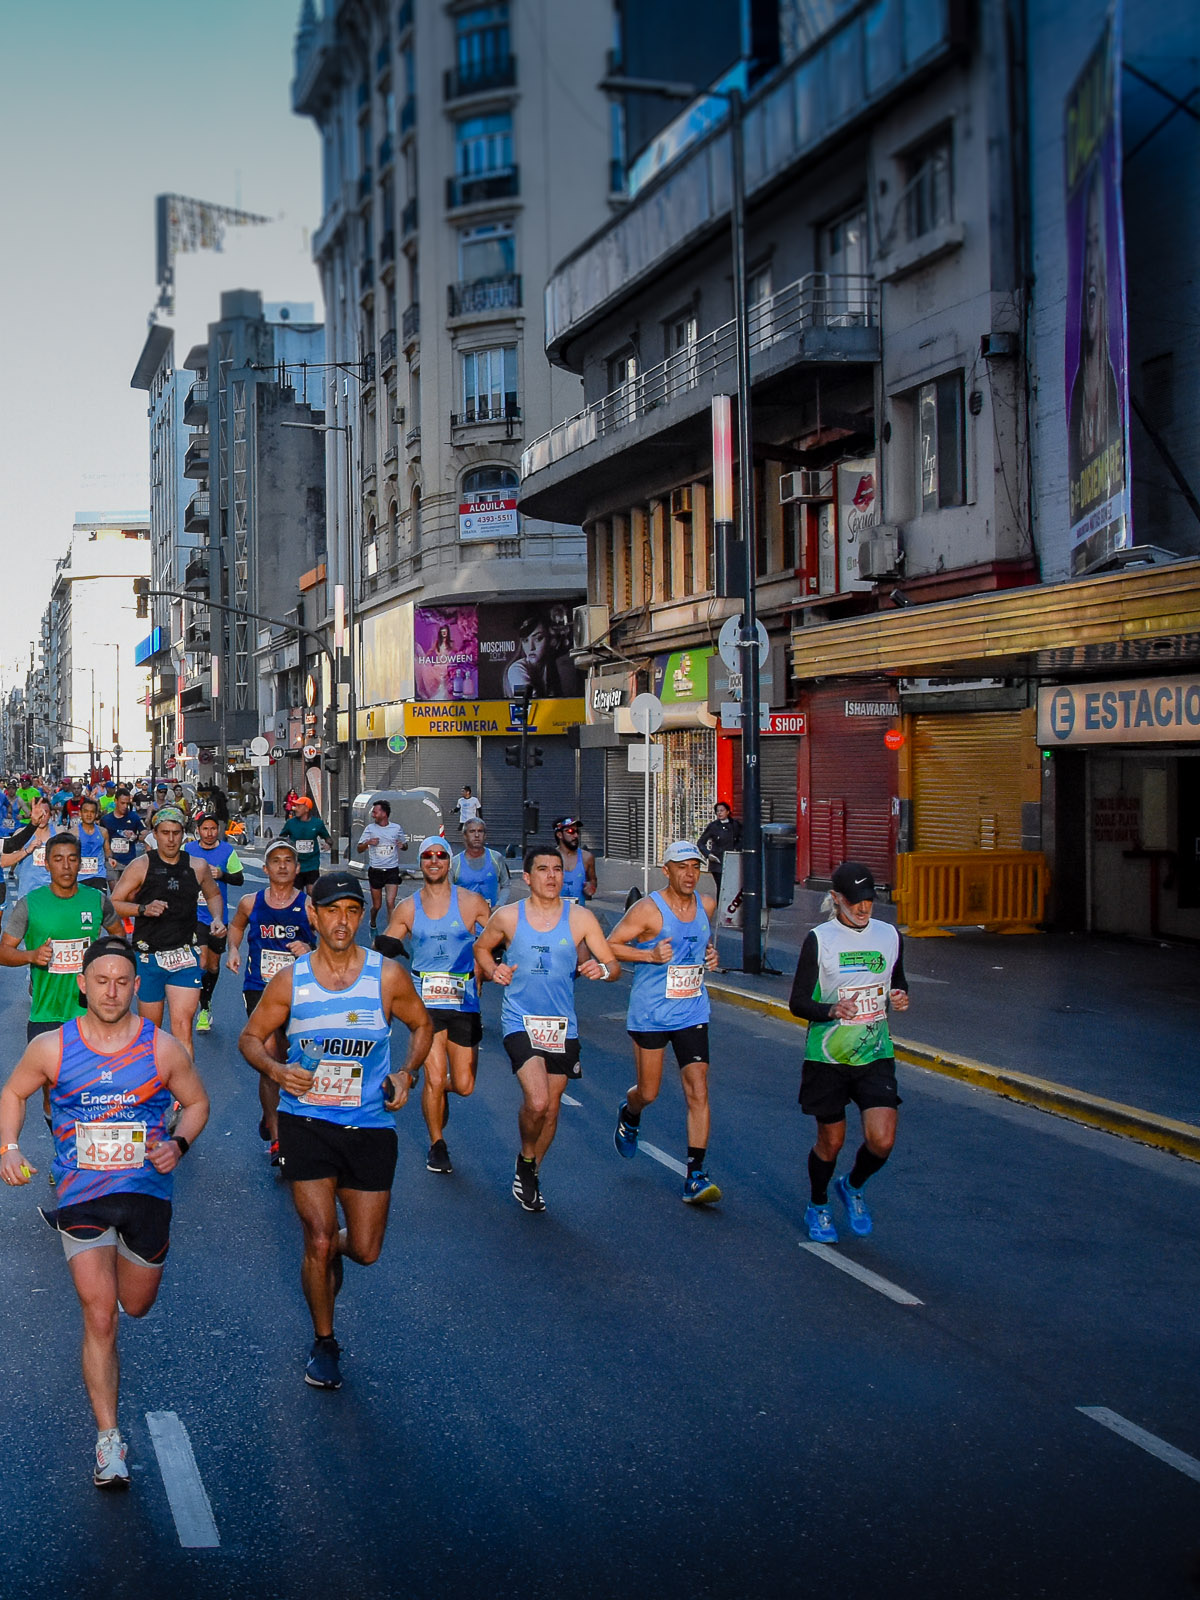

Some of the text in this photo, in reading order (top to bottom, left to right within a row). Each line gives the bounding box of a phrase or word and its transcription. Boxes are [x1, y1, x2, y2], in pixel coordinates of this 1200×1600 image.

[469, 501, 506, 513] ALQUILA
[477, 514, 513, 524] 4393-5511
[480, 641, 515, 653] MOSCHINO
[418, 654, 473, 665] HALLOWEEN
[593, 688, 622, 712] Energizer
[412, 703, 480, 718] FARMACIA Y
[848, 702, 899, 716] SHAWARMA
[1085, 685, 1200, 731] ESTACIO
[429, 720, 498, 733] PERFUMERIA
[775, 717, 804, 732] SHOP
[260, 925, 298, 939] MCS
[55, 949, 84, 963] 4351
[671, 976, 700, 987] 13046
[429, 985, 457, 995] 1890
[859, 997, 879, 1012] 115
[531, 1028, 559, 1043] 8676
[301, 1038, 377, 1058] UUGUAY
[313, 1076, 354, 1095] 4947
[81, 1089, 137, 1105] Energía
[85, 1143, 136, 1162] 4528
